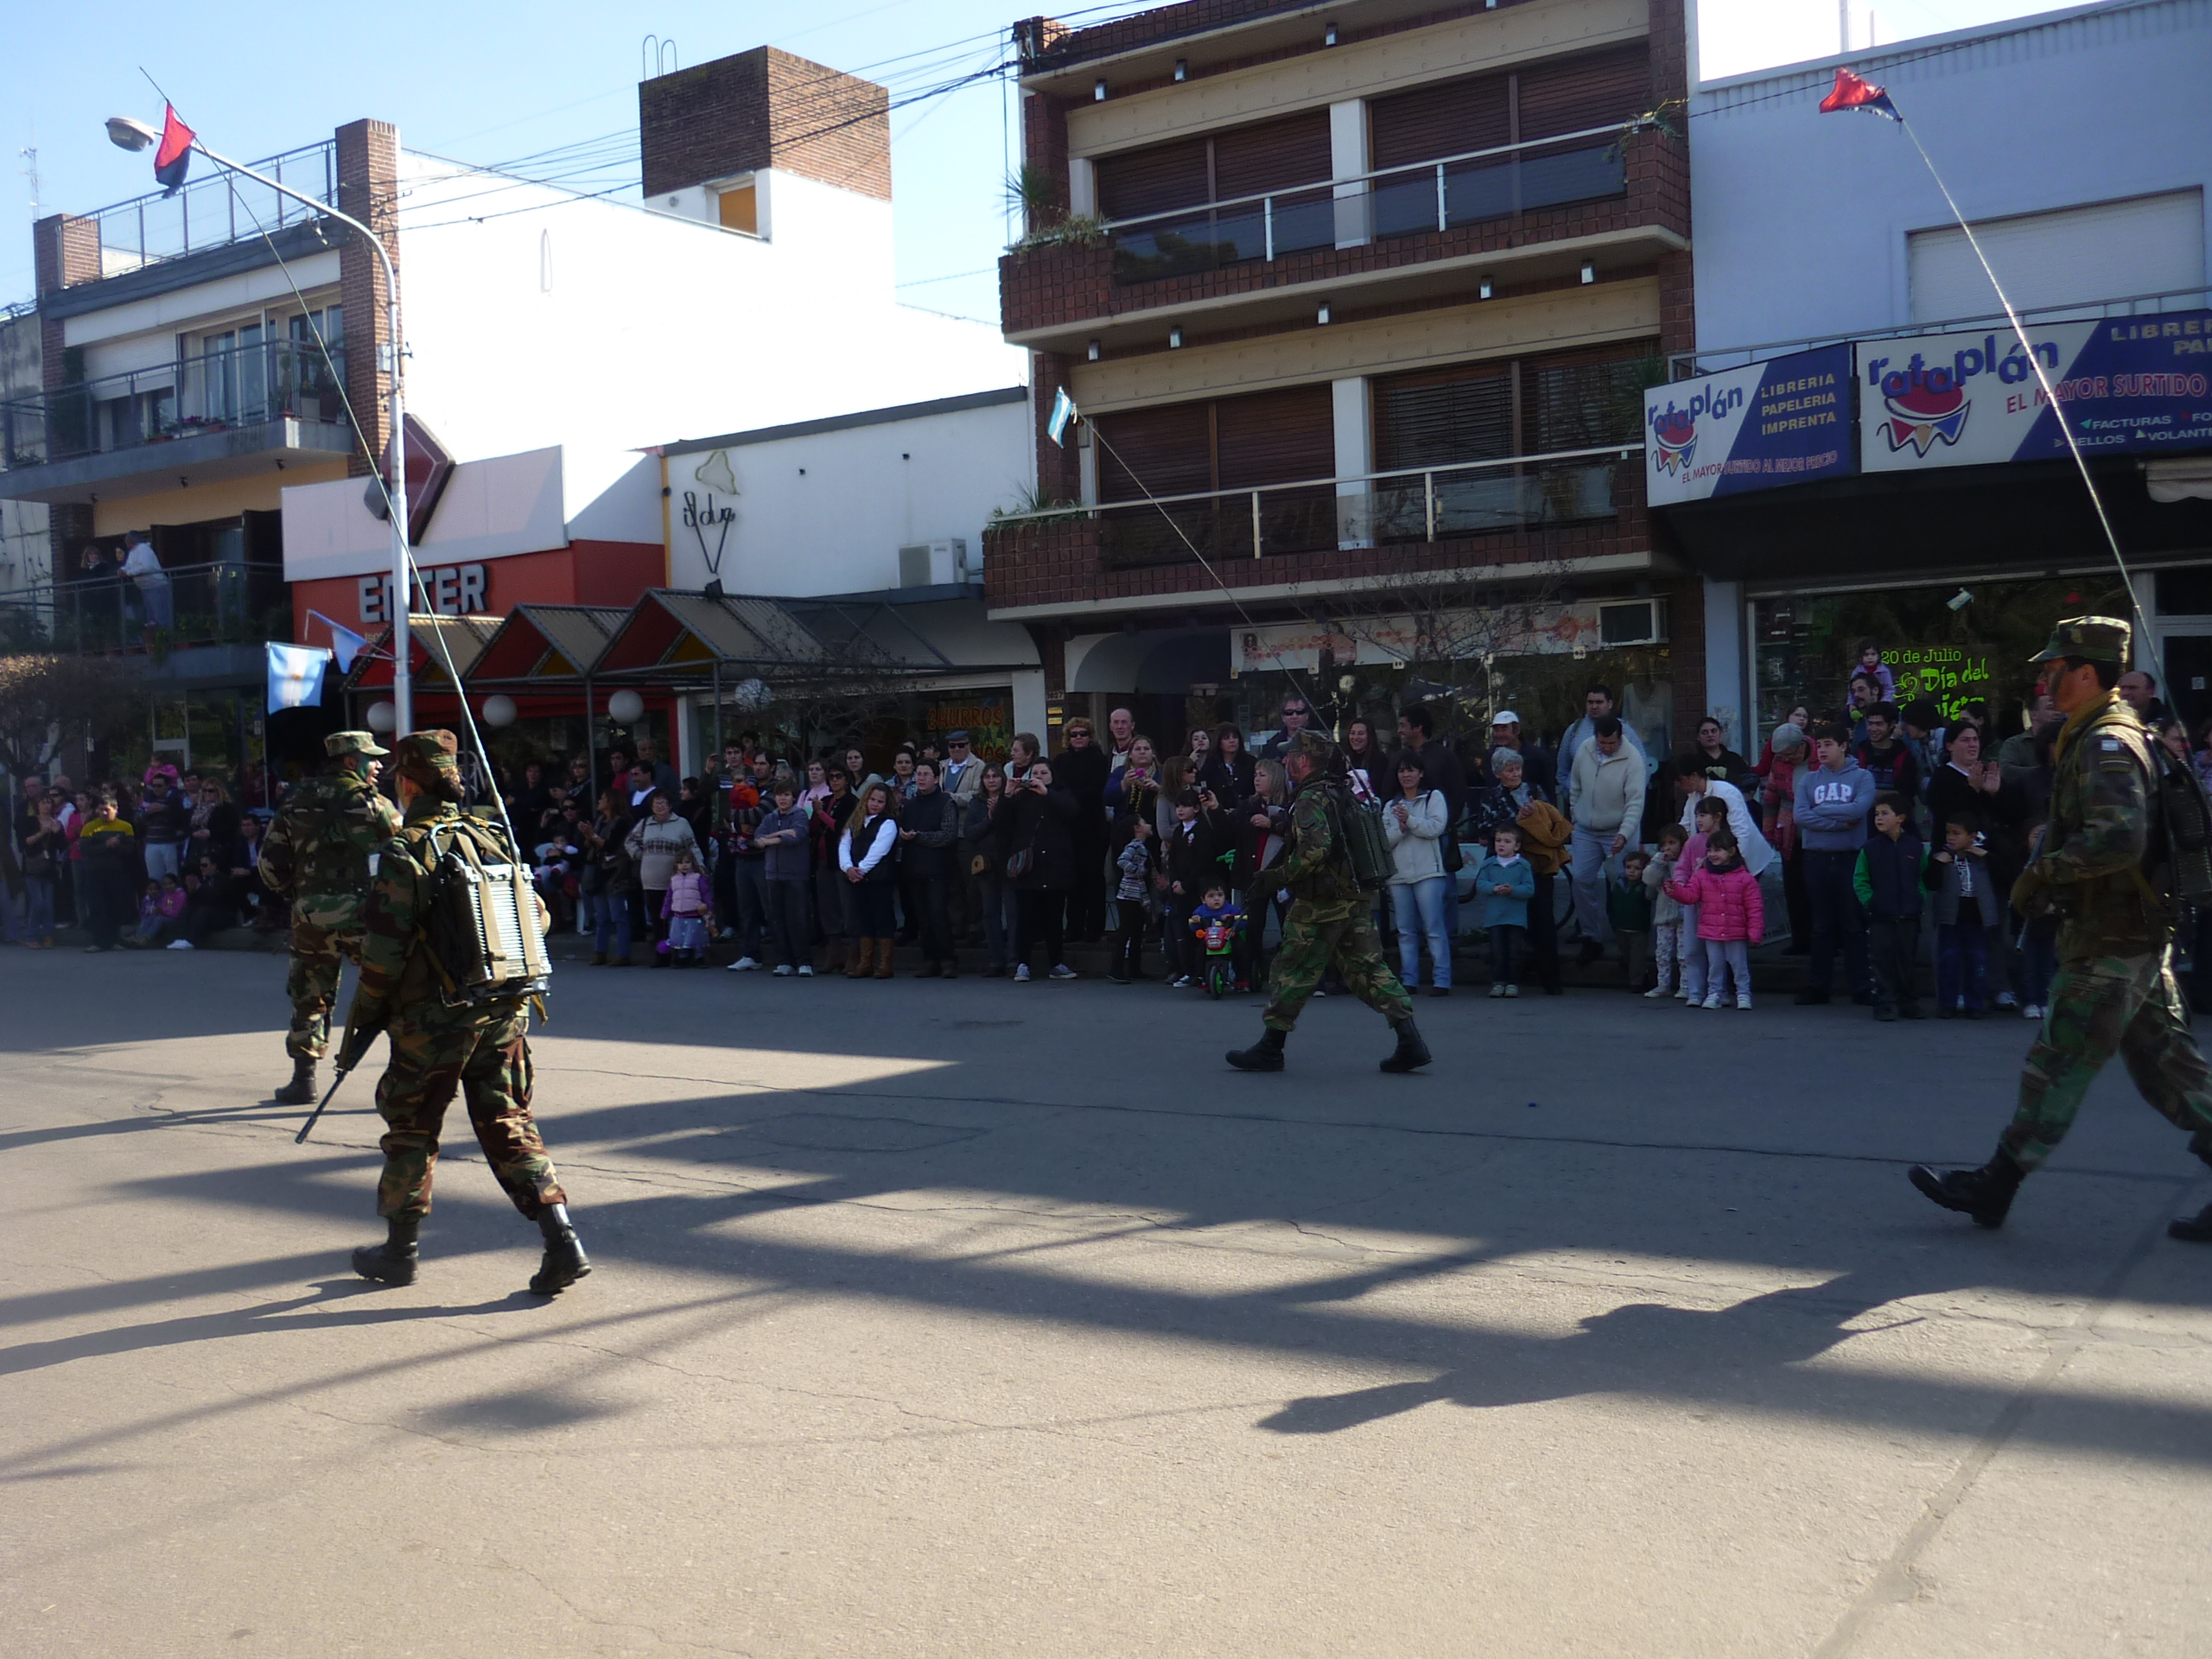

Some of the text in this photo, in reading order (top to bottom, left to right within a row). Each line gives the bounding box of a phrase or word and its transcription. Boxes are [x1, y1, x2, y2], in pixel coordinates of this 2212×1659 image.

[1869, 334, 2059, 397] rataplán
[1761, 373, 1835, 398] LIBRERIA
[2006, 373, 2207, 414] EL MAYOR SURTIDO
[1648, 384, 1743, 433] rataplán
[1762, 392, 1836, 416] PAPELERIA
[1762, 411, 1837, 435] IMPRENTA
[2093, 416, 2171, 429] FACTURAS
[1682, 450, 1838, 484] EL MAYOR SURTIDO AL MEJOR PRECIO
[1881, 648, 1962, 664] 20 de Julio
[1920, 658, 1989, 691] Día del
[927, 707, 1004, 730] CHURROS
[1815, 783, 1853, 804] GAP
